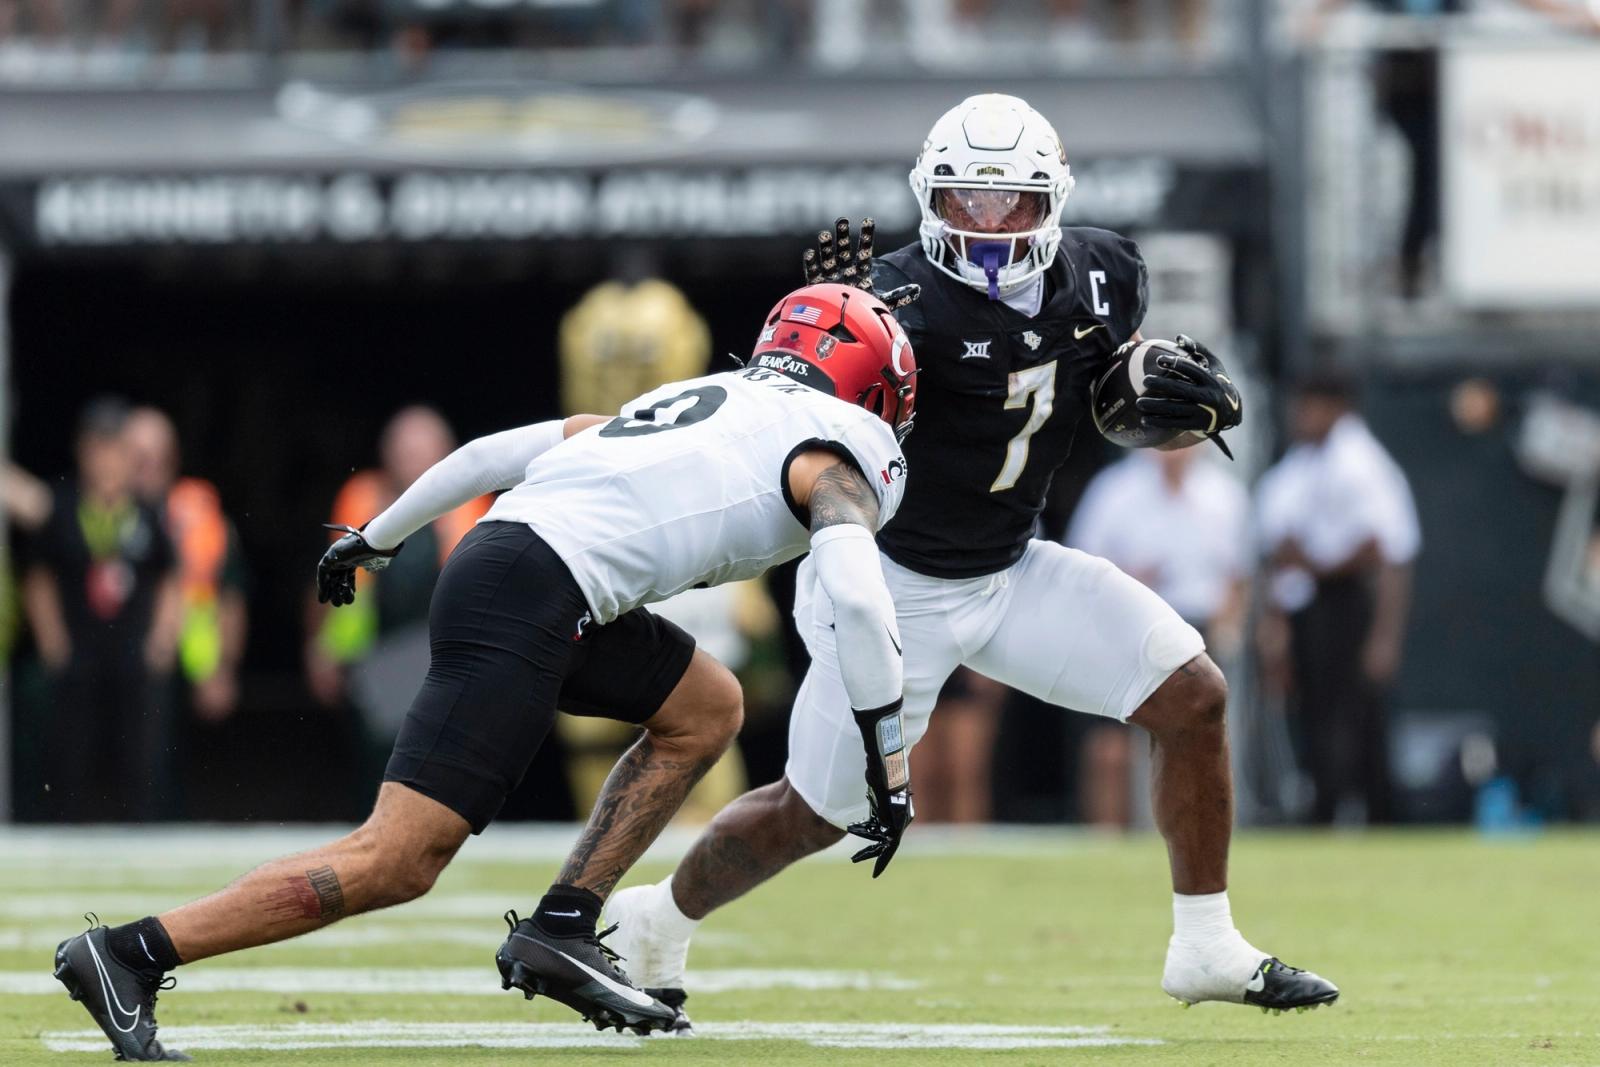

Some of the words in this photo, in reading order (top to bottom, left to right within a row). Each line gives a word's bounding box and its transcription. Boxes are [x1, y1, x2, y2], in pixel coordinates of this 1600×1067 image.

[1089, 270, 1110, 315] C
[962, 340, 992, 359] XII
[990, 360, 1058, 493] 7
